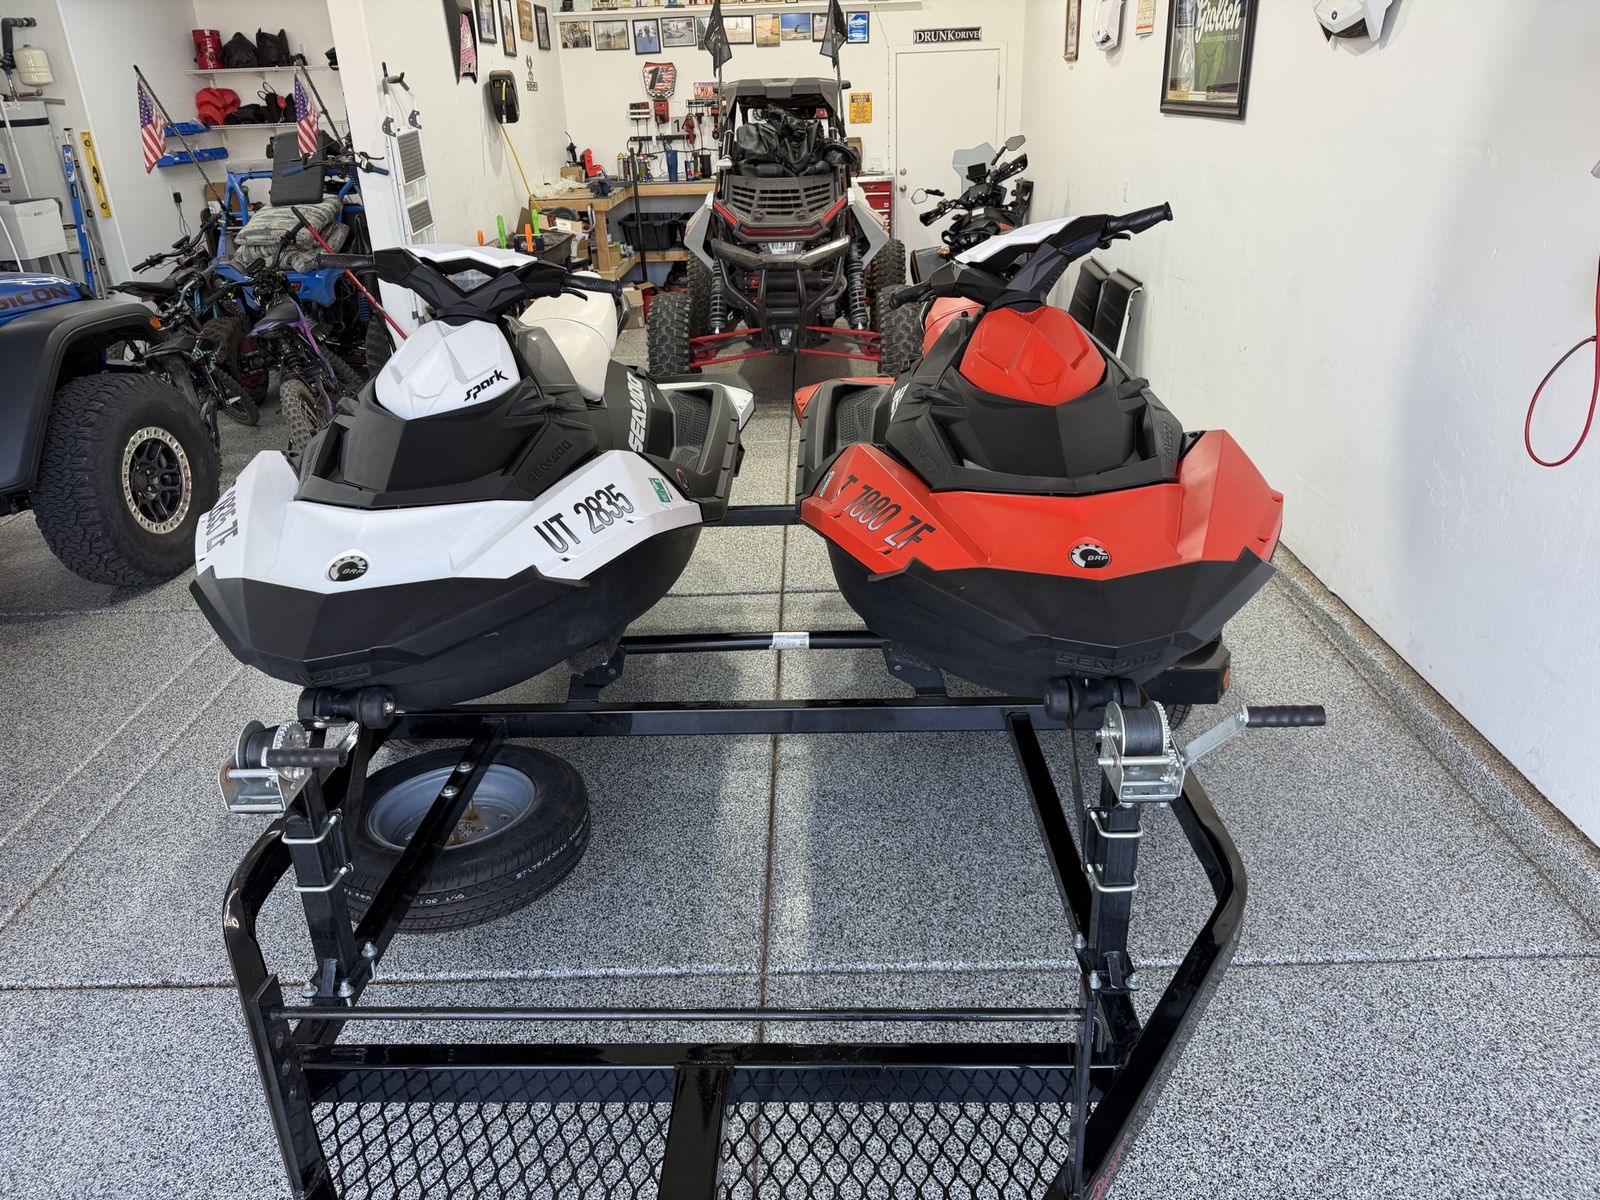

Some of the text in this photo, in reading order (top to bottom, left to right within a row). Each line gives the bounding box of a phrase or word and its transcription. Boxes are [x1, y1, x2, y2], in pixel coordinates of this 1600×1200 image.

[915, 29, 980, 43] DRUNK DRIVE
[533, 512, 581, 554] UT
[573, 483, 635, 535] 2835
[842, 484, 902, 532] 7880
[884, 515, 936, 550] ZF
